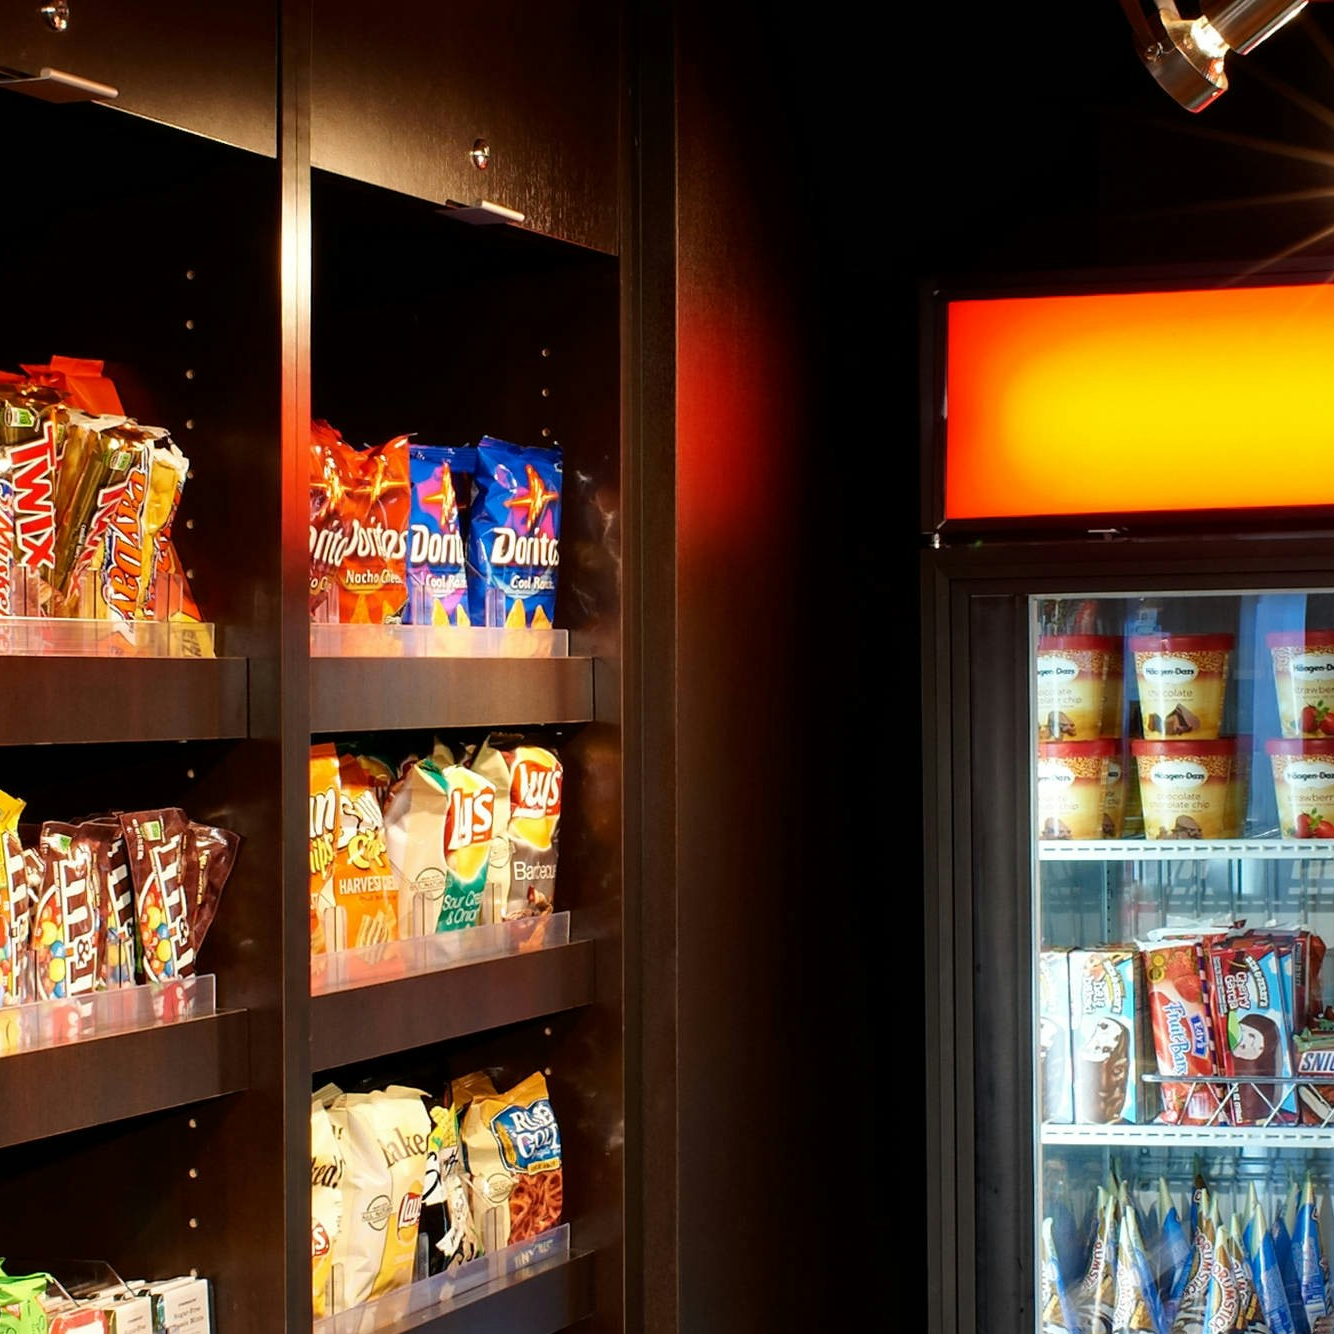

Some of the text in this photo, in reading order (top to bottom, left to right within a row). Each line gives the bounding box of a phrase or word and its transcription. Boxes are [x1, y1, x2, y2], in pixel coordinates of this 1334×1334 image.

[11, 420, 57, 578] TWIX
[346, 569, 379, 586] Nacho
[426, 574, 446, 588] Cool
[510, 574, 532, 589] Cool
[1192, 801, 1211, 812] chip
[339, 877, 380, 896] HARVEST
[444, 894, 463, 913] Sour
